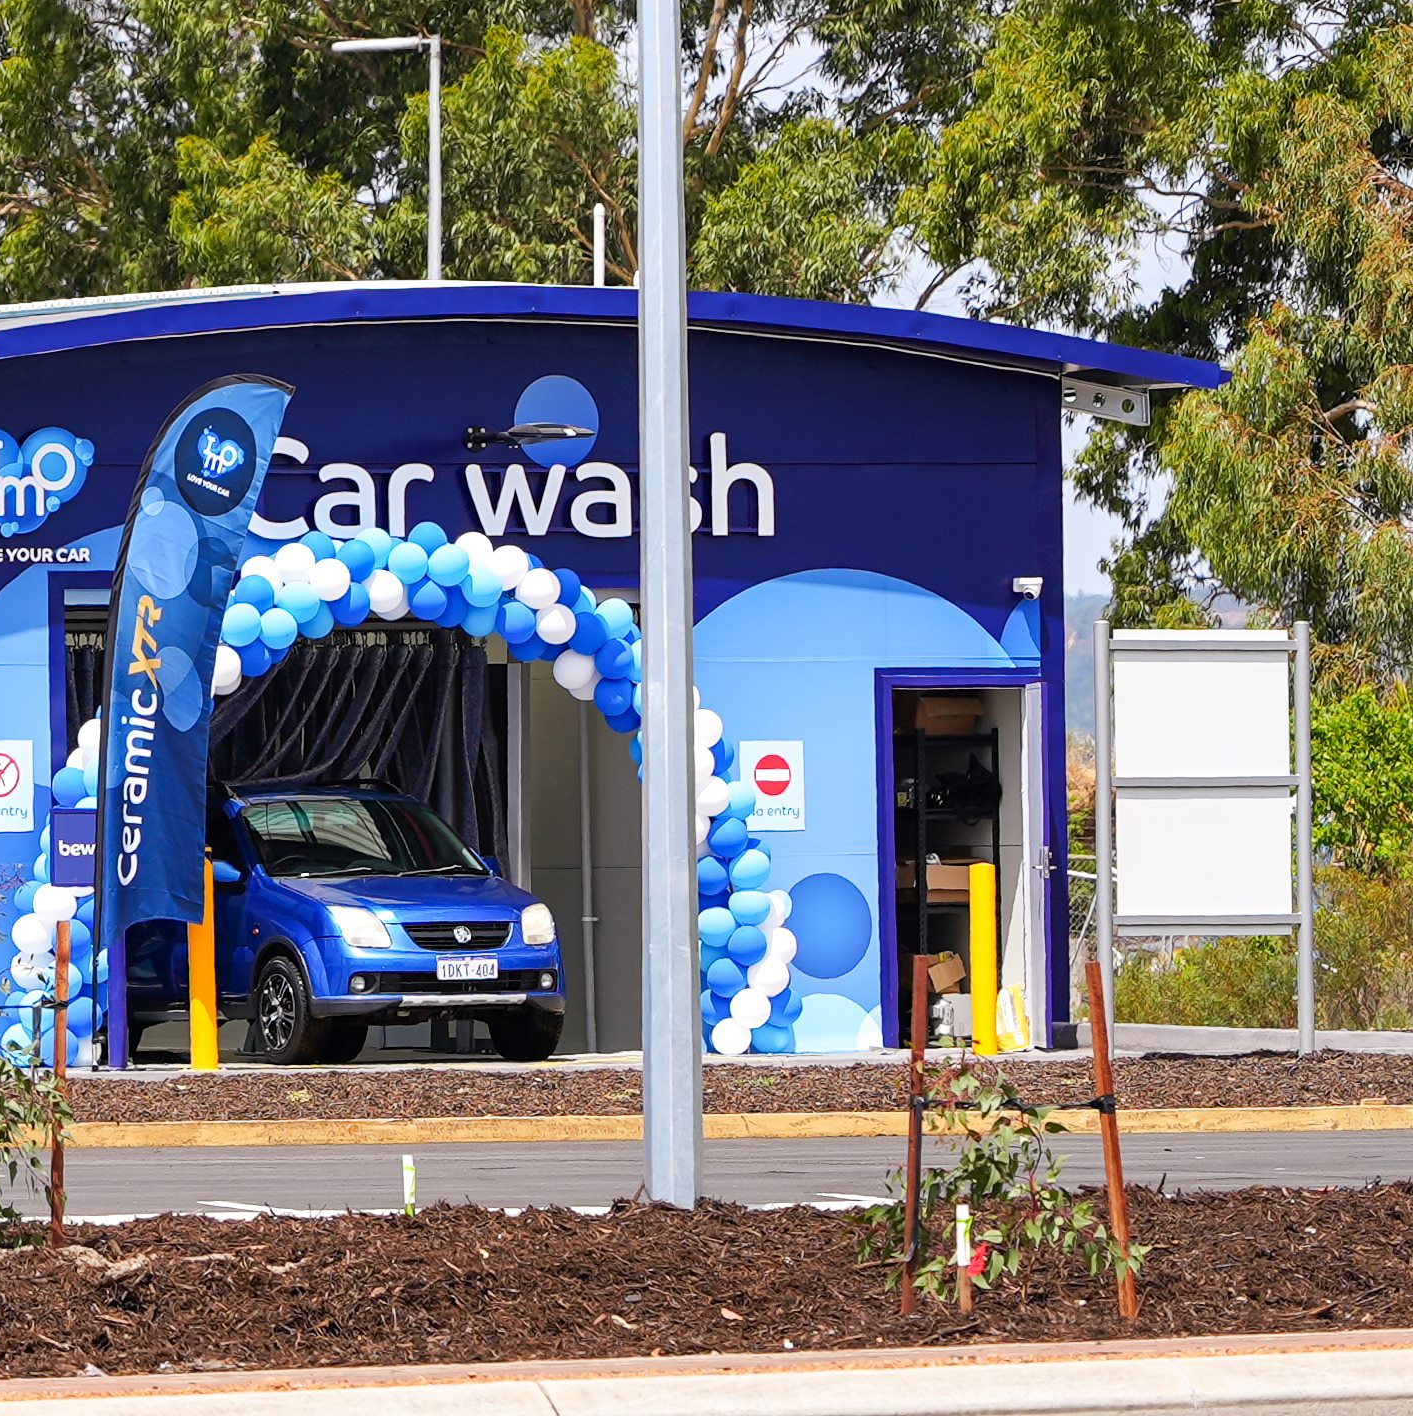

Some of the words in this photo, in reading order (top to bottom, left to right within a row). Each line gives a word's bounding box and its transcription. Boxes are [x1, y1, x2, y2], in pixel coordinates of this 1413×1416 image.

[186, 472, 203, 486] LOVE
[202, 479, 219, 493] YOUR
[248, 435, 435, 541] Car
[6, 548, 54, 563] YOUR
[55, 547, 91, 562] CAR
[117, 688, 159, 887] ceramic
[753, 807, 764, 817] o
[767, 806, 801, 819] entry
